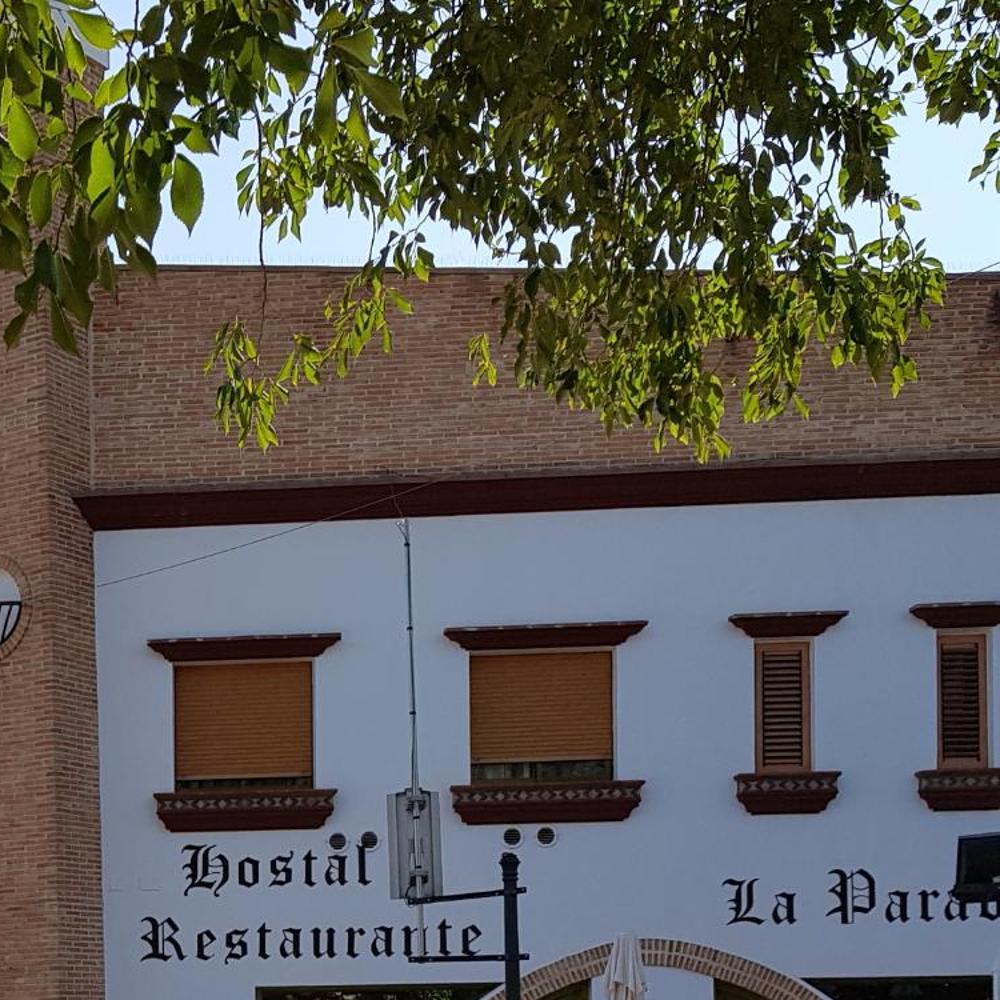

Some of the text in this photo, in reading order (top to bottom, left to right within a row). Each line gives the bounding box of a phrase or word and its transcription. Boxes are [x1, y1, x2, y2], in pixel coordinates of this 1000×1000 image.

[181, 843, 373, 897] Hostal
[722, 878, 798, 926] La
[140, 917, 482, 965] Restaurante
